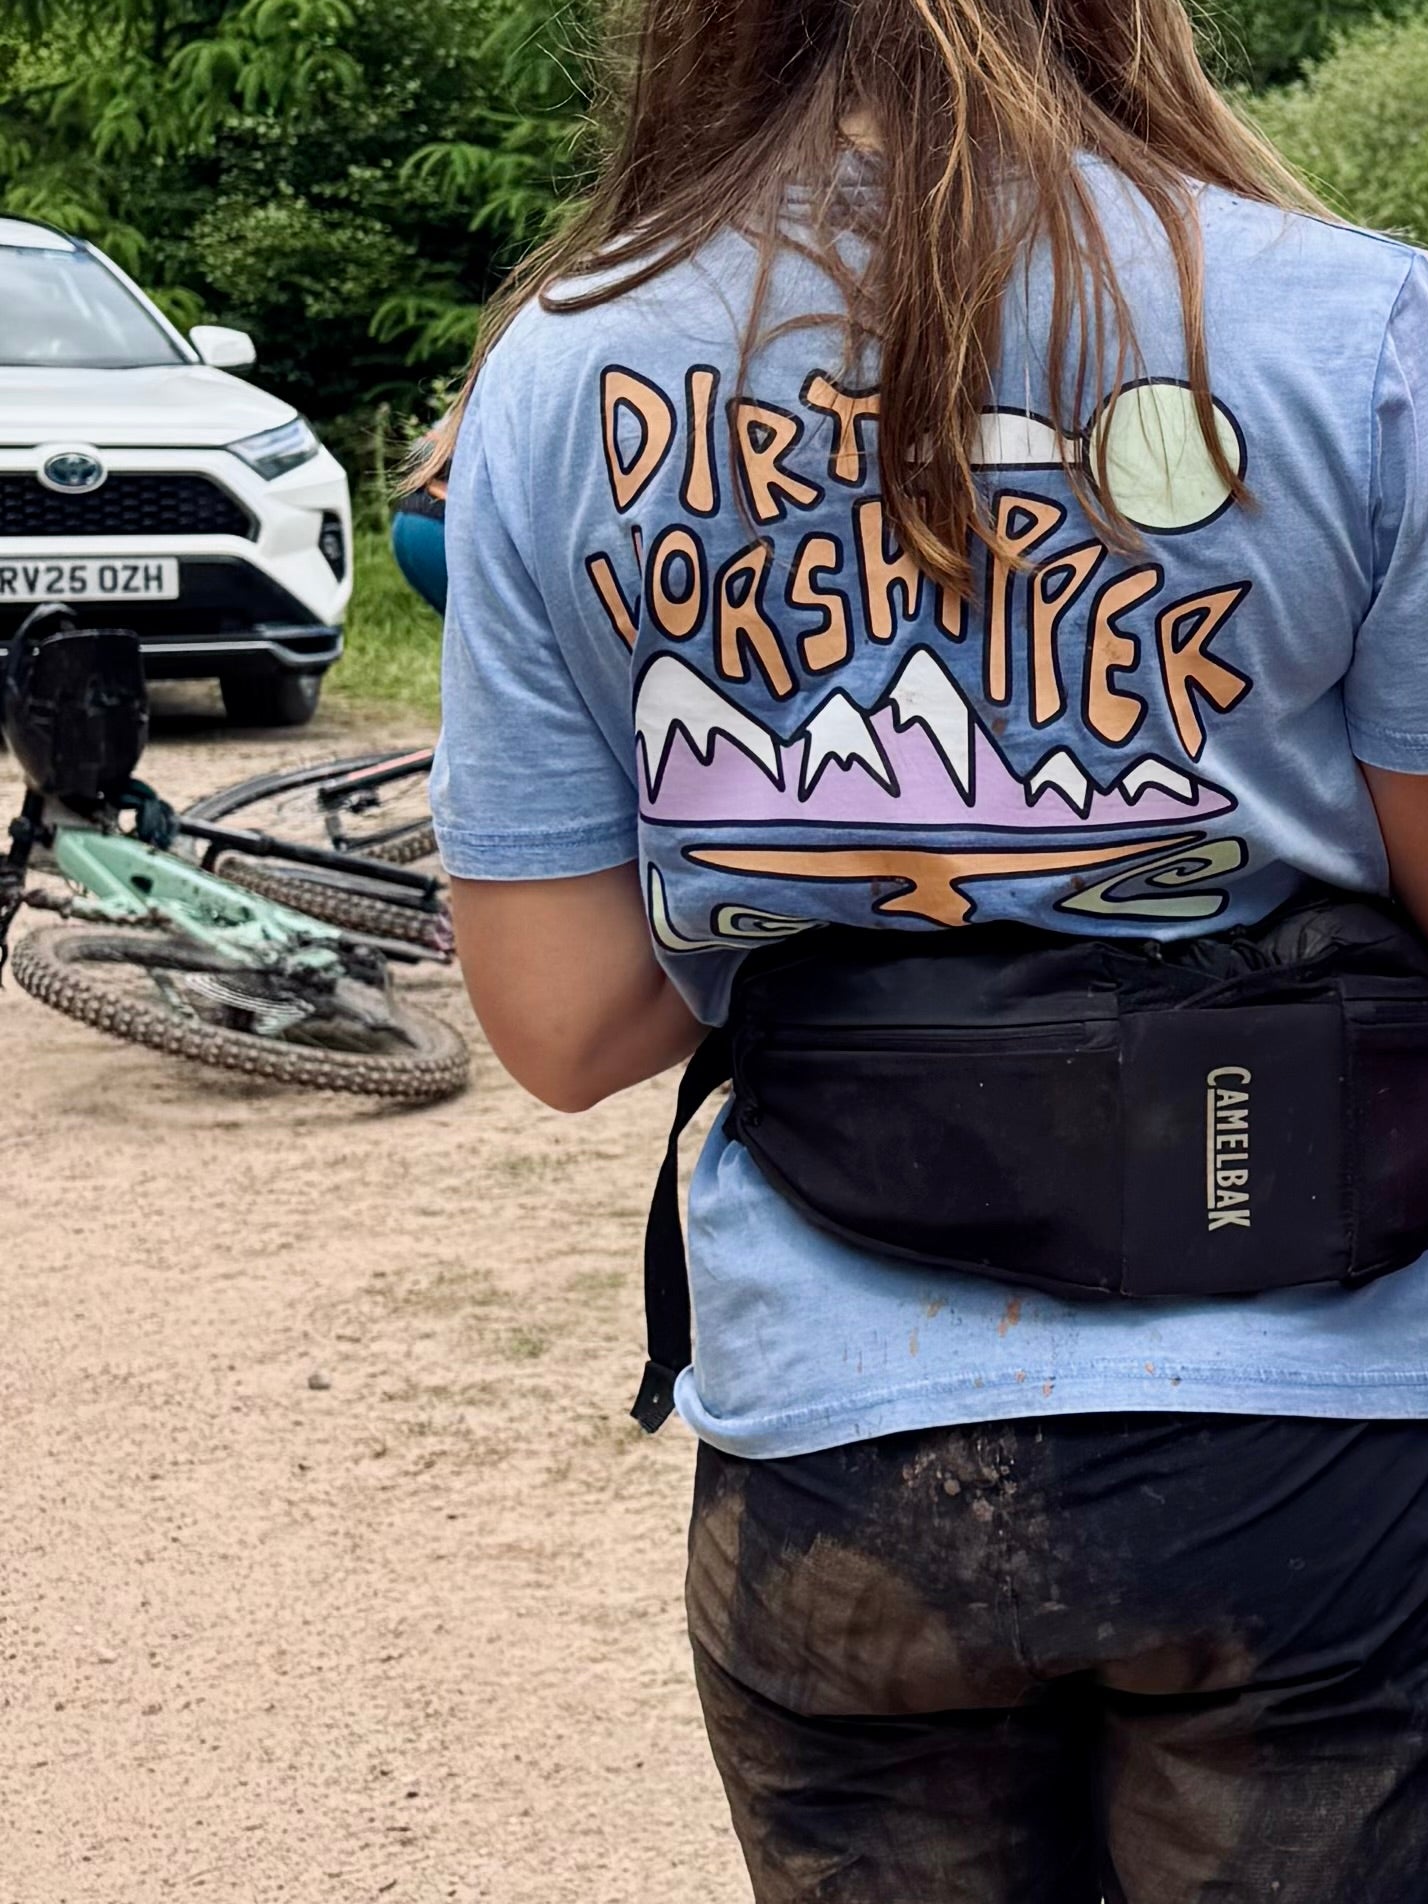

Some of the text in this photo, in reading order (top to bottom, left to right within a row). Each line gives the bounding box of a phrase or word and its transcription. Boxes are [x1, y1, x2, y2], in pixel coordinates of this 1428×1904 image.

[600, 364, 882, 526] DIRT
[0, 564, 163, 594] RV25 OZH
[1206, 1066, 1251, 1231] CAMELBAK
